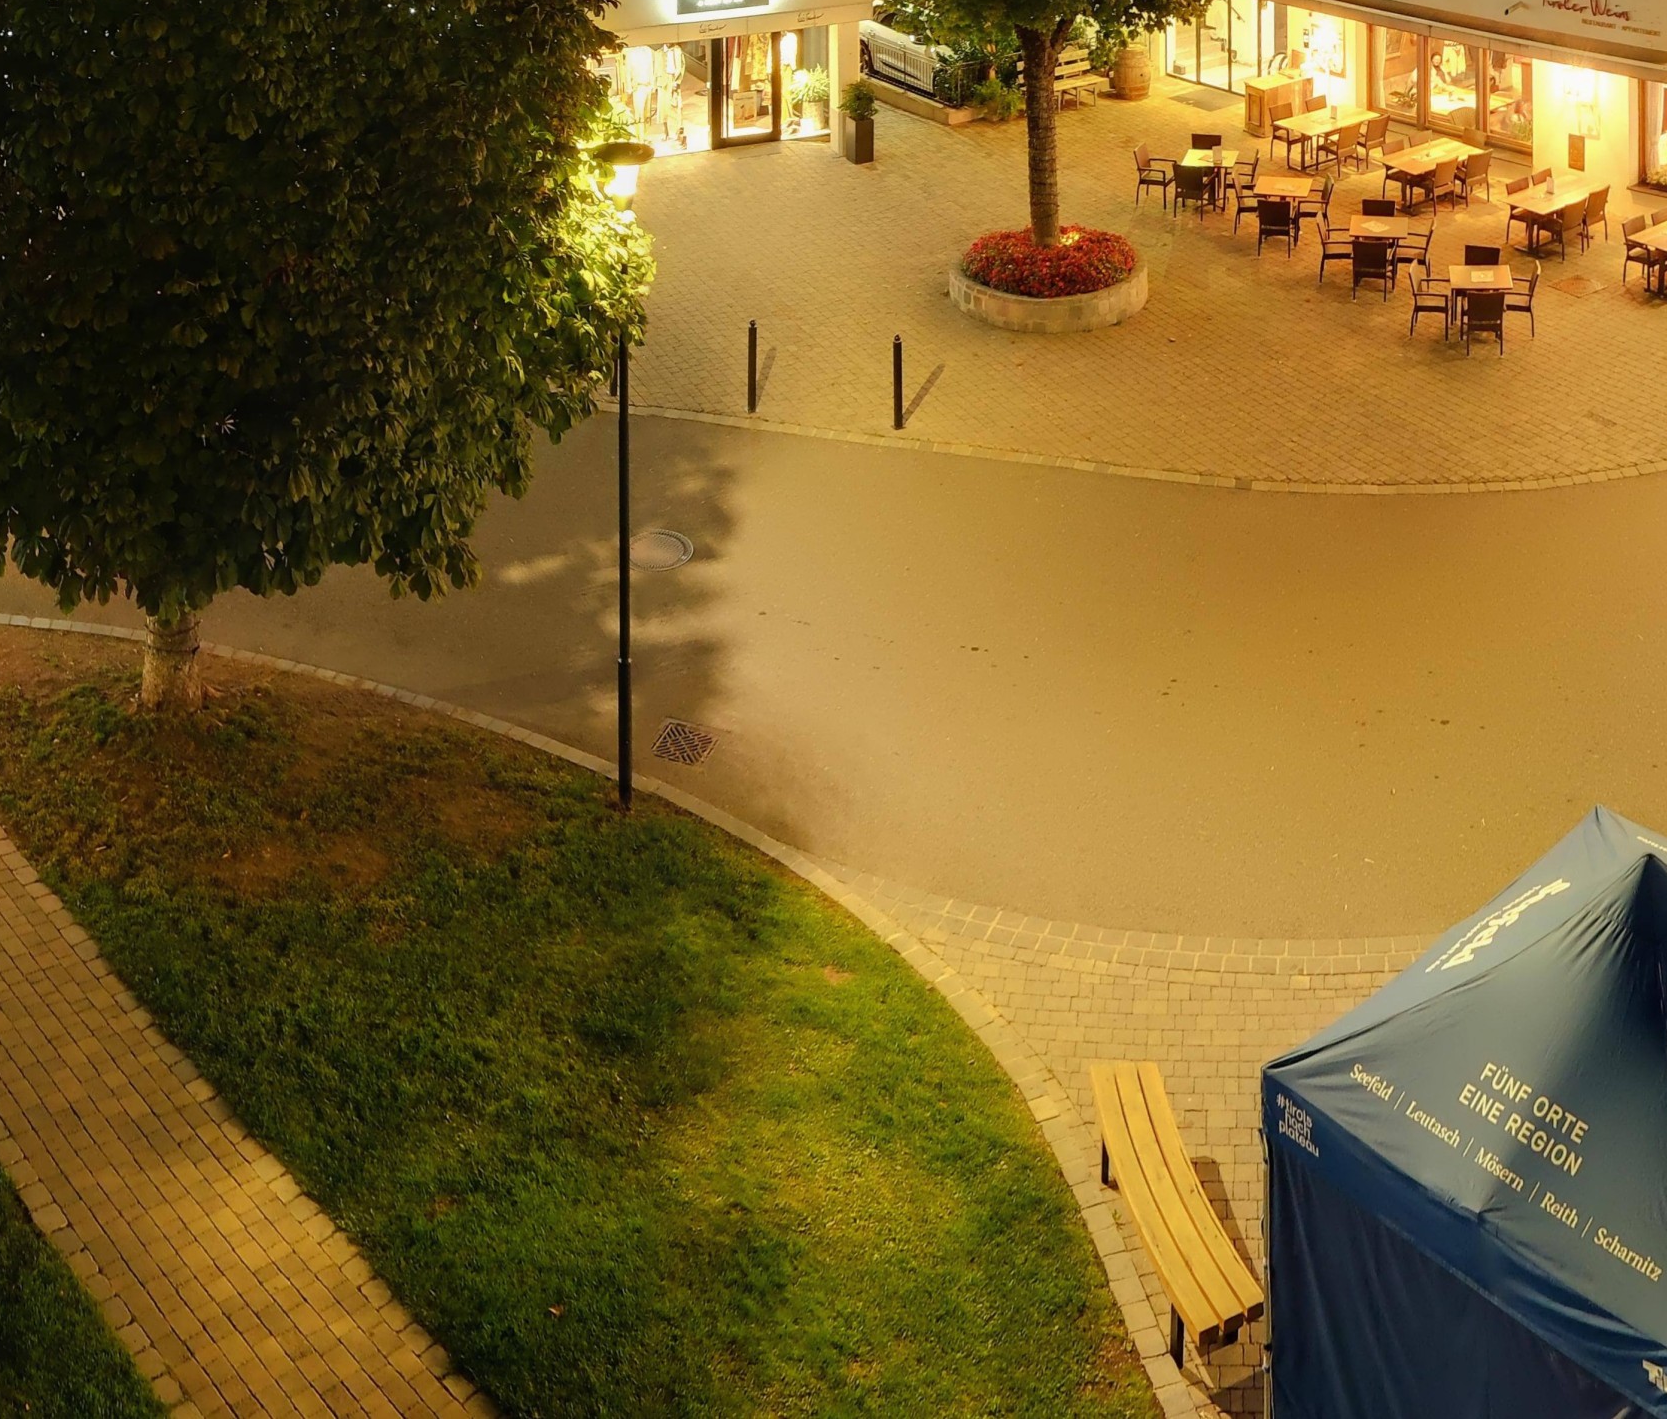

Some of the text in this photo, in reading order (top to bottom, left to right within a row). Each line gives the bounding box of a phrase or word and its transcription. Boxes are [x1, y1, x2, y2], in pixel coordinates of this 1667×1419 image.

[1276, 1093, 1313, 1129] #tirols
[1284, 1109, 1311, 1141] hoch
[1458, 1083, 1583, 1178] EINE REGION
[1479, 1062, 1590, 1145] FÜNF ORTE
[1278, 1120, 1320, 1158] plateau
[1350, 1063, 1663, 1282] Seefeld Leutasch Mösern Reith Scharnitz
